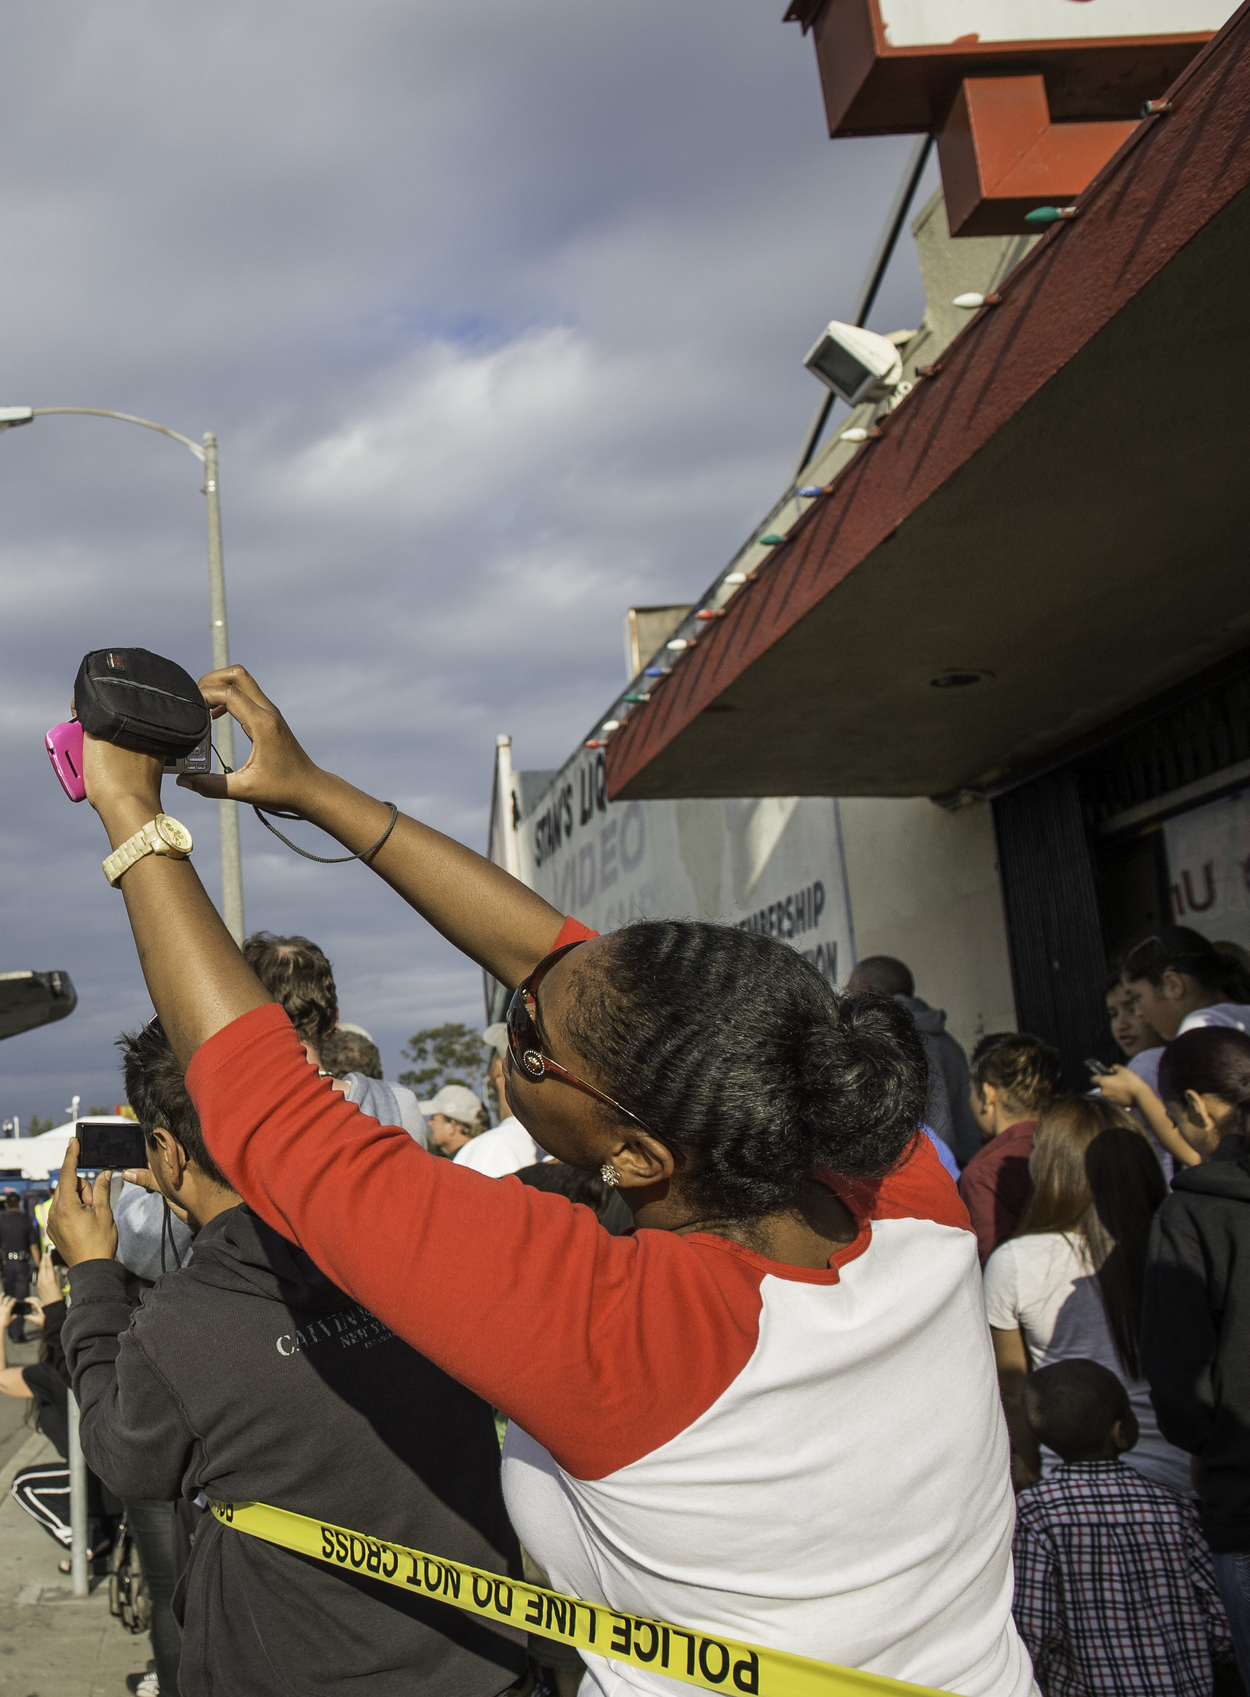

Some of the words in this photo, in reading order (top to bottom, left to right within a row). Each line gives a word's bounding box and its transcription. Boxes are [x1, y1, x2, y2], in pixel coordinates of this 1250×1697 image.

[276, 1309, 358, 1357] CALVIN
[321, 1526, 399, 1579] CROSS
[406, 1552, 462, 1600] NOT
[472, 1572, 513, 1616] DO
[525, 1593, 597, 1644] LINE
[610, 1612, 760, 1696] POLICE
